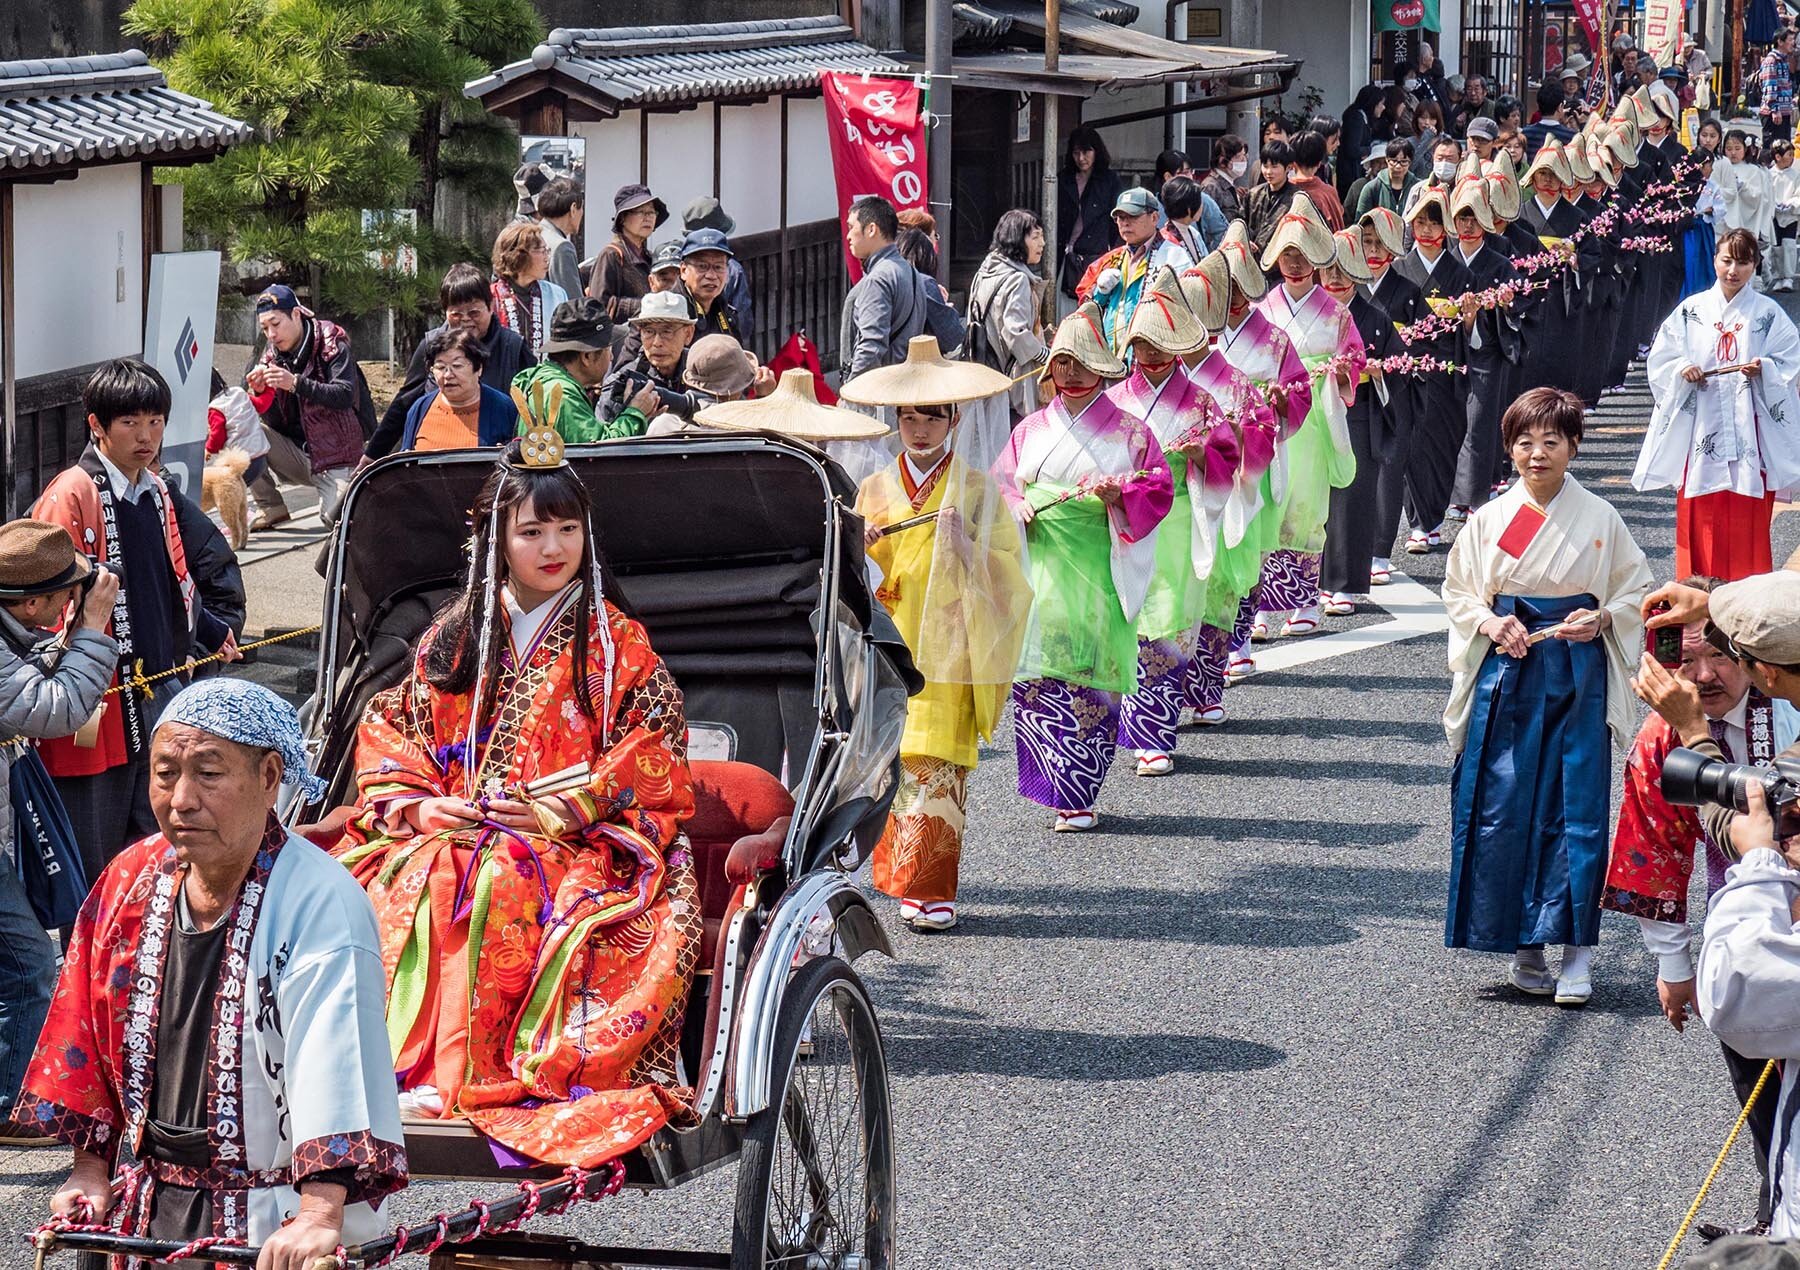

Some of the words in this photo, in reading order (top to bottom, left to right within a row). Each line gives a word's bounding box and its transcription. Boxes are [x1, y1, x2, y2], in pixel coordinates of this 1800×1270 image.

[99, 489, 134, 656] 岡山県立高等学校
